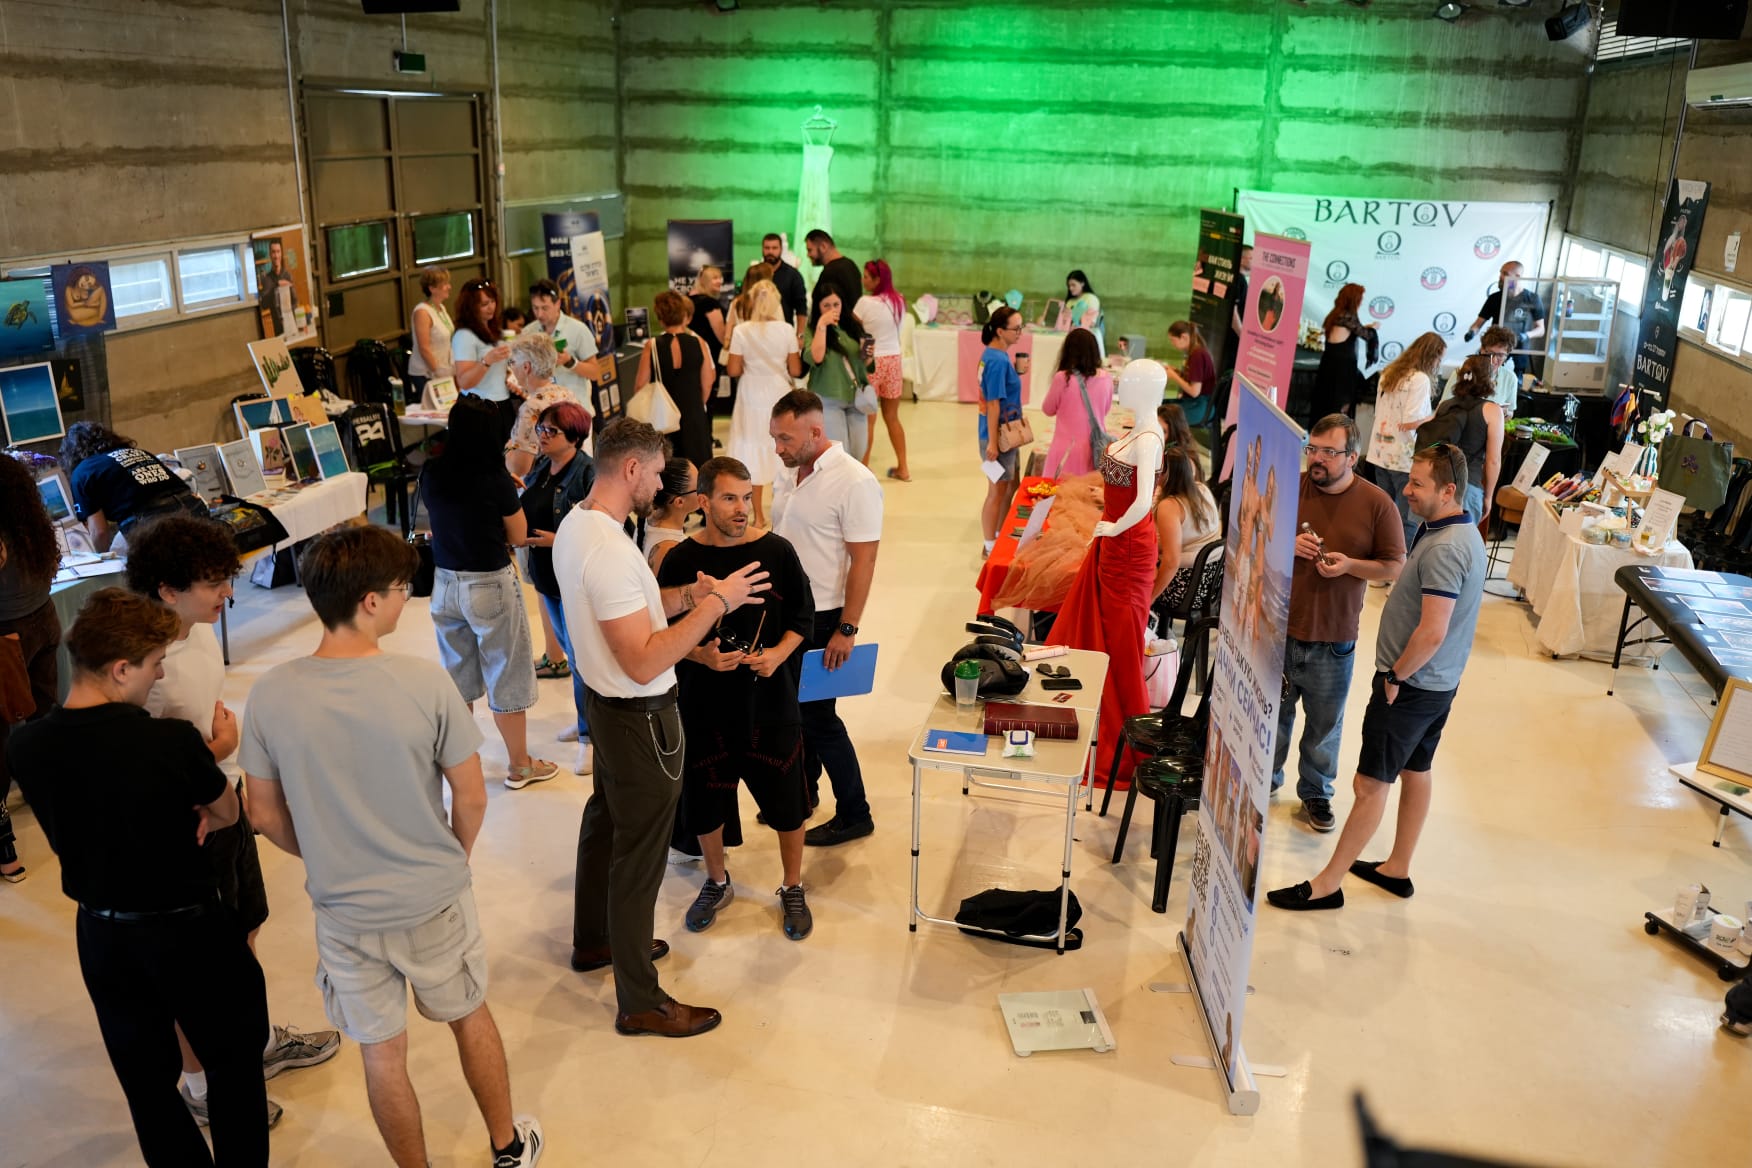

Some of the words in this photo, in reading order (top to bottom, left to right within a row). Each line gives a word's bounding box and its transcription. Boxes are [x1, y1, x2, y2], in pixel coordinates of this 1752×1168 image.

[1314, 198, 1467, 228] BARTOV
[1636, 354, 1669, 383] BARTOV
[134, 468, 167, 481] ONES
[1237, 679, 1271, 756] СЕЙЧАС!
